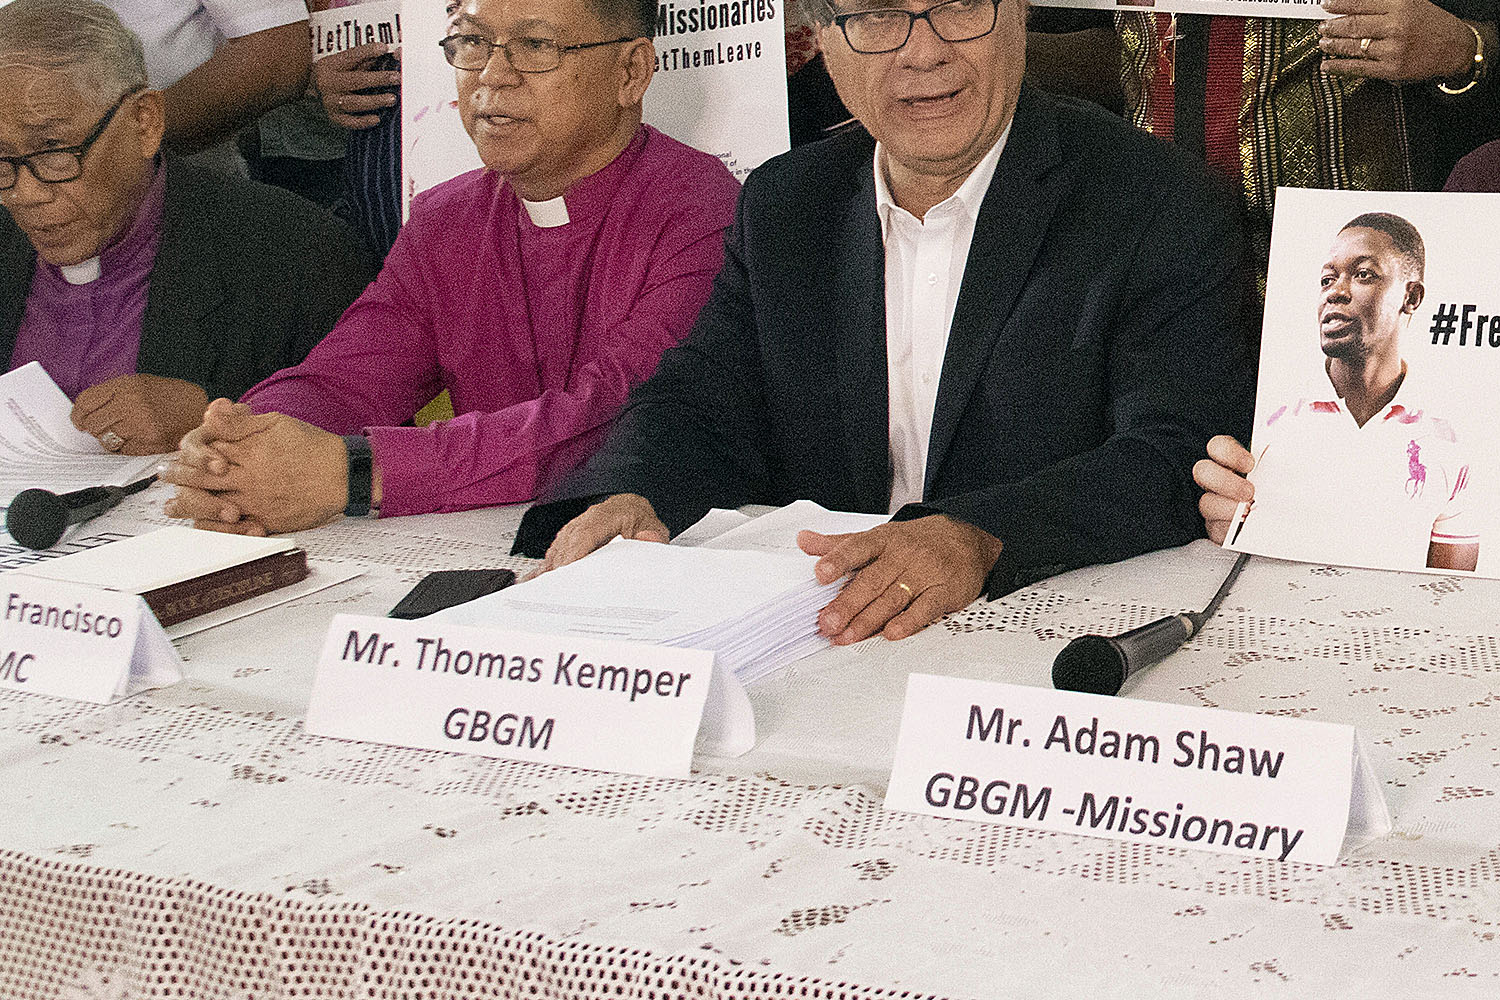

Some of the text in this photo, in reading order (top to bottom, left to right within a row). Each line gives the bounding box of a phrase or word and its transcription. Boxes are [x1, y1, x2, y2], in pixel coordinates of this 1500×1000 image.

[5, 592, 122, 638] Francisco
[342, 629, 691, 703] Mr. Thomas Kemper
[442, 706, 556, 751] GBGM
[965, 704, 1285, 779] Mr. Adam Shaw
[924, 771, 1303, 862] GBGM -Missionary
